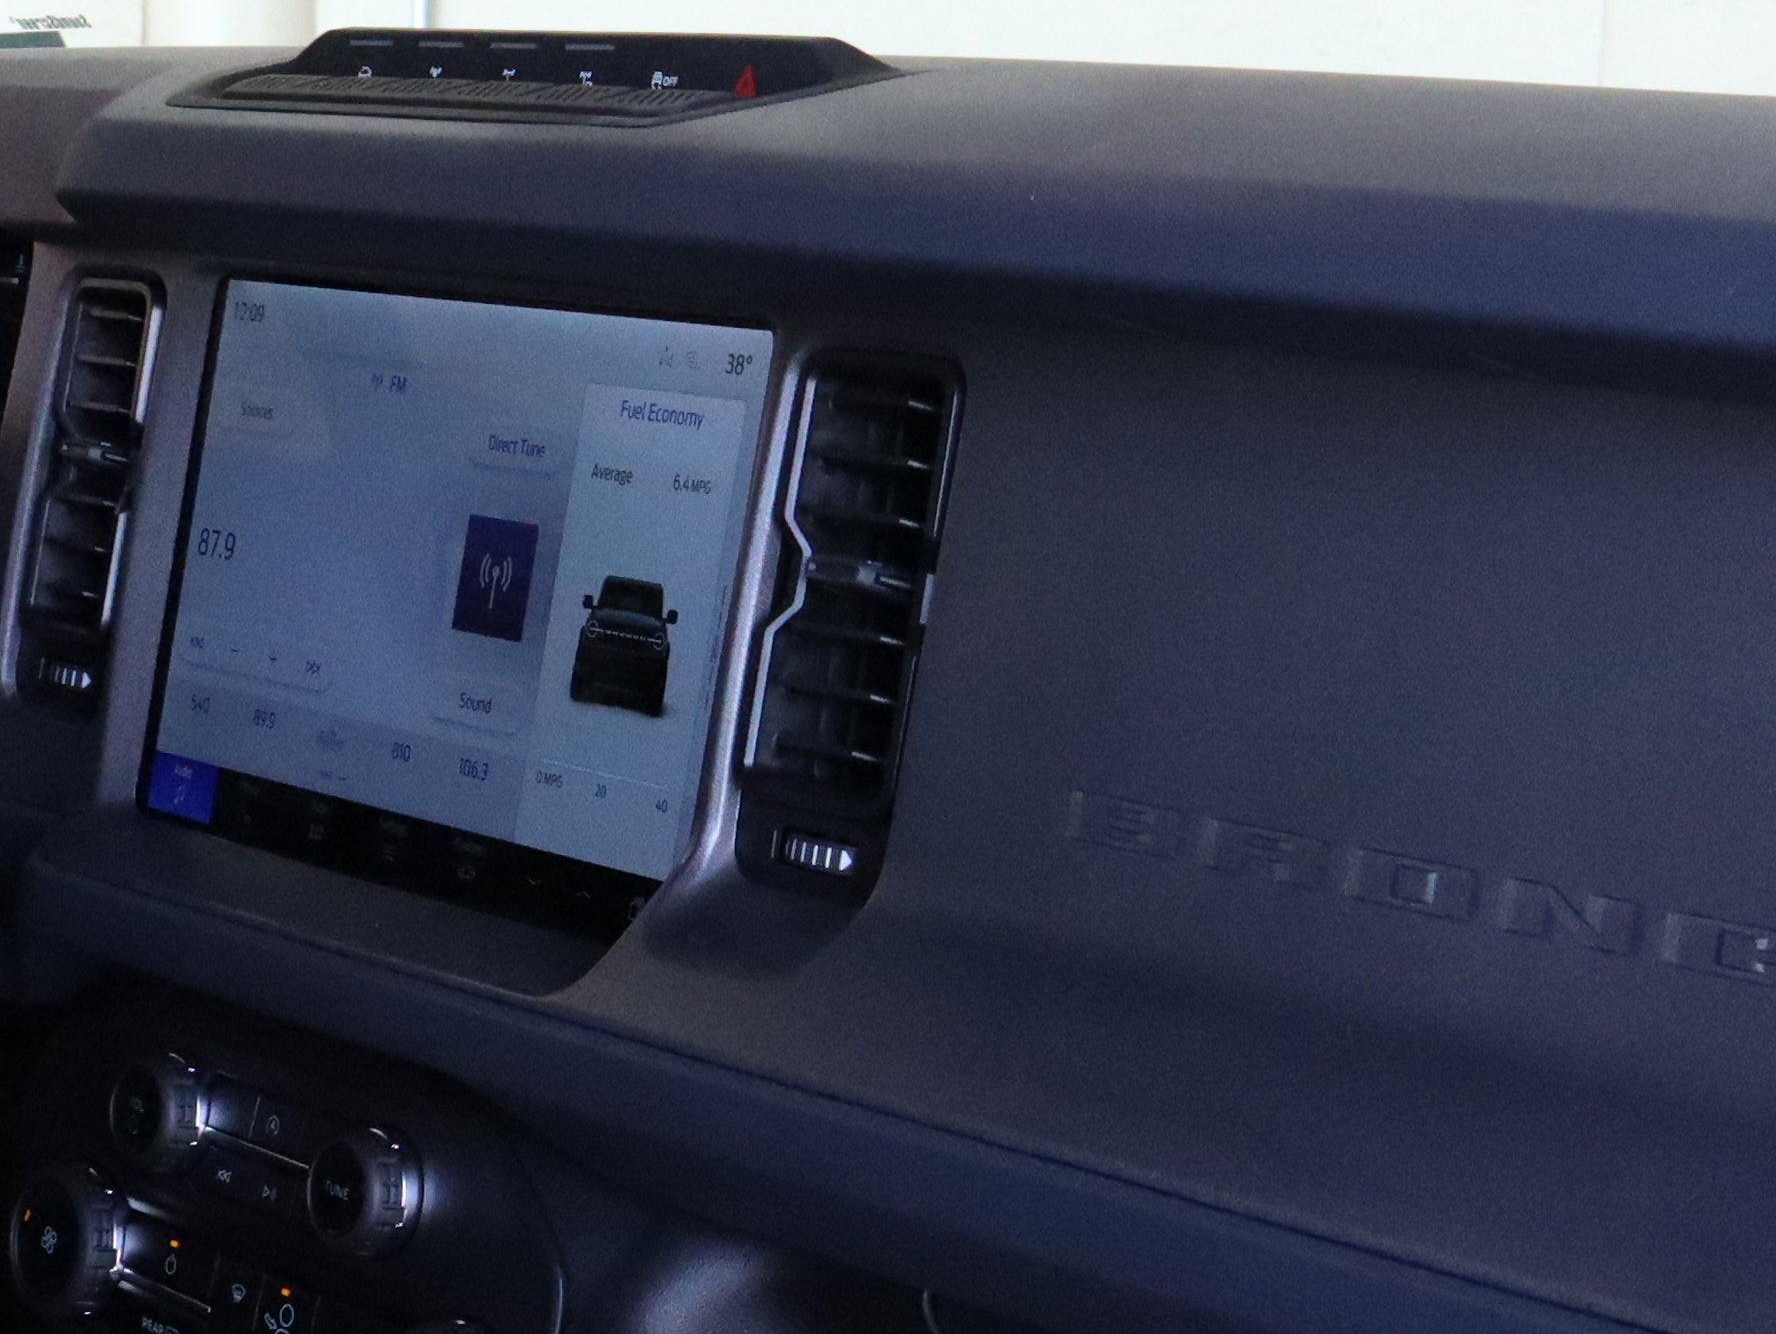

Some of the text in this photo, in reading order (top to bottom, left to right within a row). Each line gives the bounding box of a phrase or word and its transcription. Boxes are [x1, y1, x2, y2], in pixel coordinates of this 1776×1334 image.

[390, 375, 408, 393] FM
[620, 400, 705, 430] Fuel Economy
[488, 434, 546, 458] Direct Tune
[591, 463, 634, 486] Average
[197, 527, 237, 561] 87.9
[459, 692, 493, 715] Sound
[141, 1315, 165, 1334] REAR
